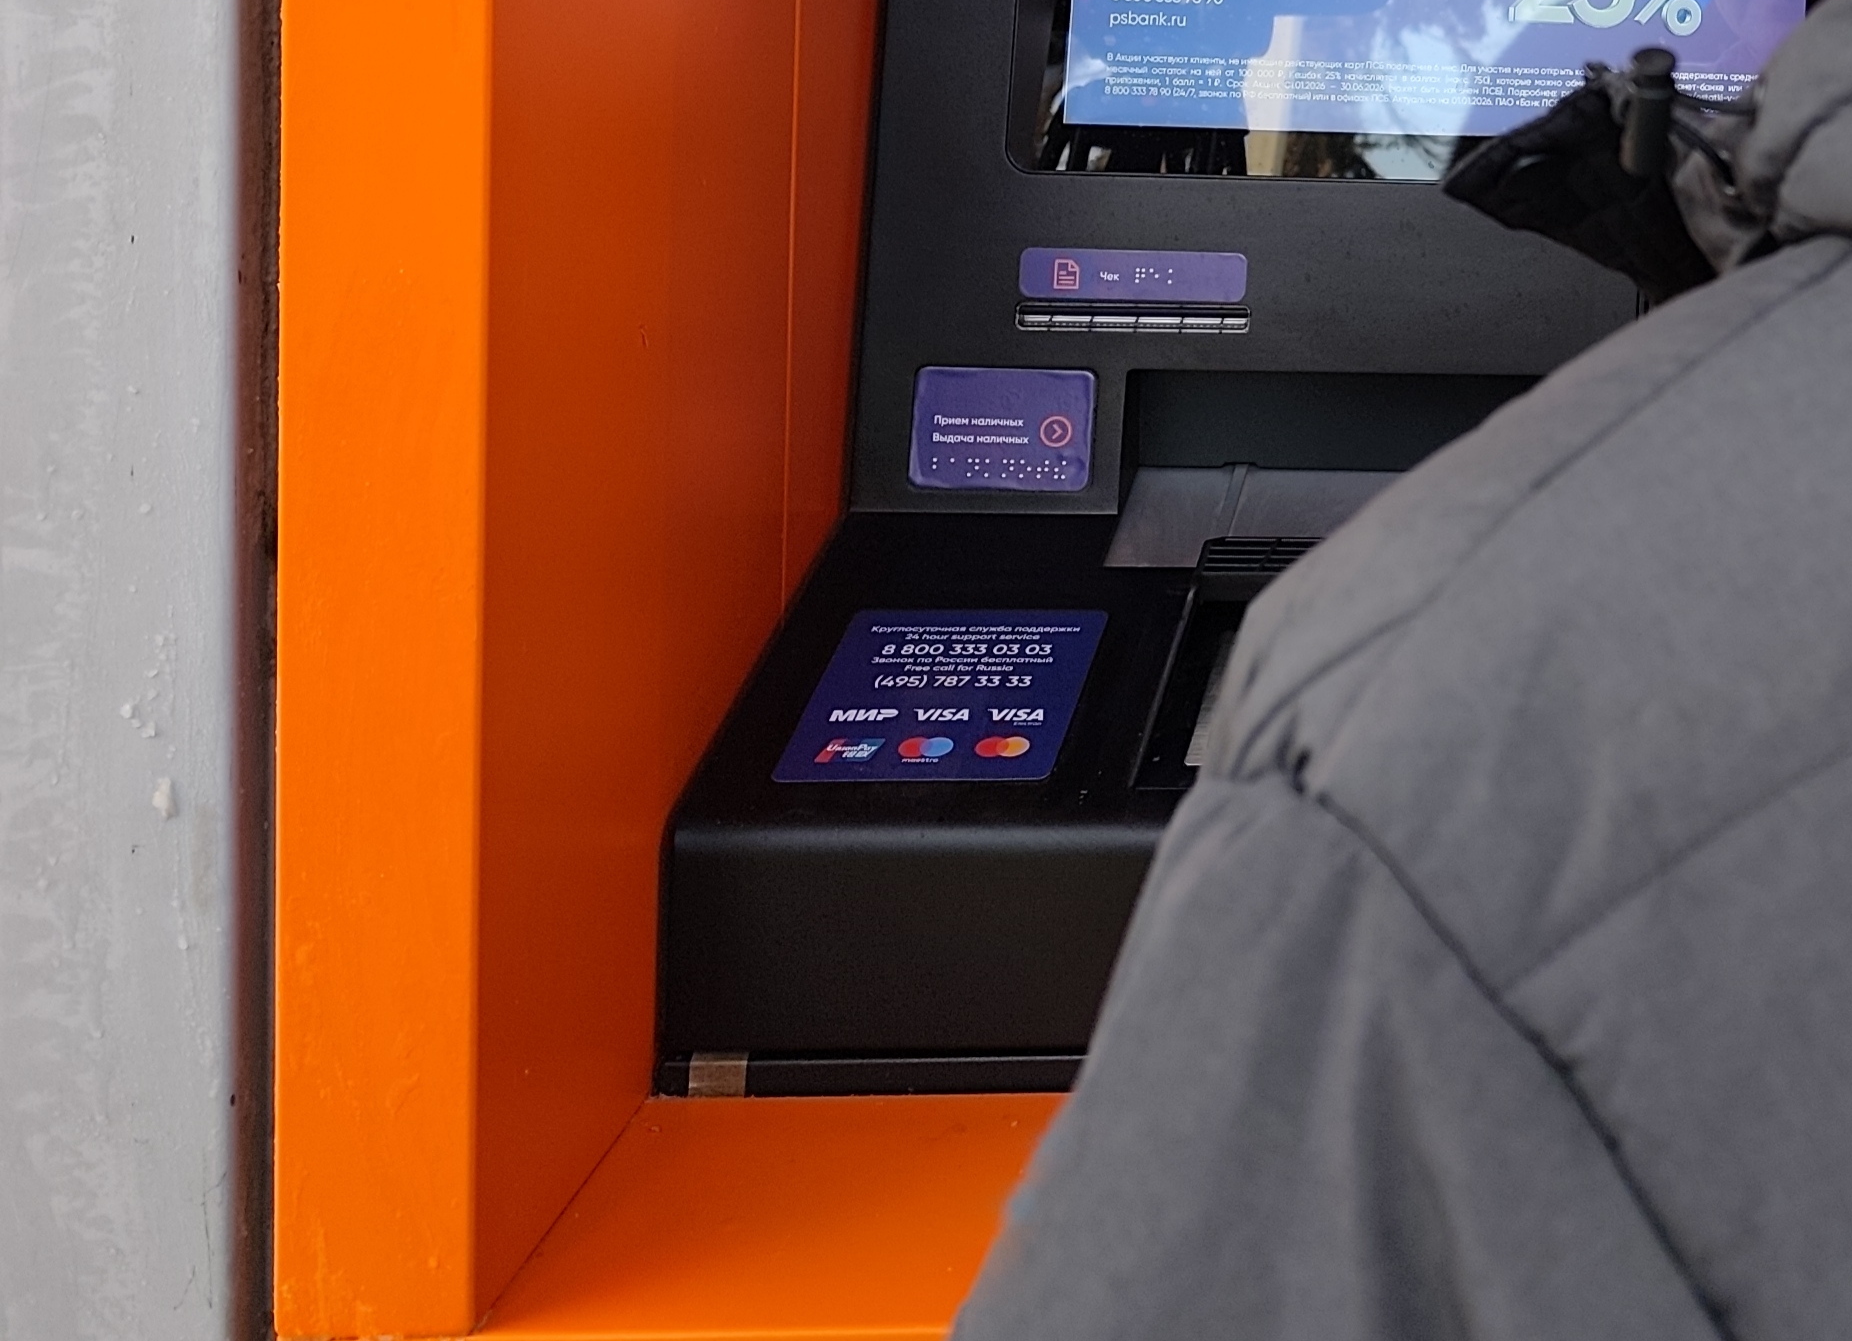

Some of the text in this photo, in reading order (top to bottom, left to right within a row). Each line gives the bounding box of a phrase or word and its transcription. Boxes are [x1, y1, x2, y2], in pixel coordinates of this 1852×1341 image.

[1109, 11, 1187, 28] psbank.ru
[1115, 53, 1142, 62] Акции
[1143, 55, 1188, 64] участвуют
[1366, 61, 1385, 70] ПСБ
[1460, 63, 1476, 73] Для
[1477, 65, 1511, 74] участия
[1513, 67, 1540, 75] нужно
[1541, 68, 1574, 76] открыть
[1151, 67, 1187, 75] остаток
[1496, 78, 1532, 87] которые
[1534, 79, 1562, 87] можно
[1172, 76, 1195, 86] балл
[1104, 85, 1111, 94] 8
[1112, 85, 1129, 95] 800
[1131, 86, 1146, 95] 333
[1149, 87, 1158, 96] 78
[1160, 87, 1171, 96] 90
[1495, 97, 1514, 106] ПАО
[1100, 271, 1120, 281] Чек
[934, 414, 1024, 427] Прием наличных
[932, 432, 1029, 444] Выдача наличных
[871, 625, 1081, 634] Круглосуточная служба поддержки
[951, 633, 998, 641] support
[882, 644, 1053, 655] 8 800 333 03 03
[874, 674, 1033, 688] (495) 787 33 33
[828, 708, 899, 721] МИР
[913, 708, 970, 721] VISA
[987, 708, 1044, 721] VISA
[826, 743, 878, 752] UnionPay
